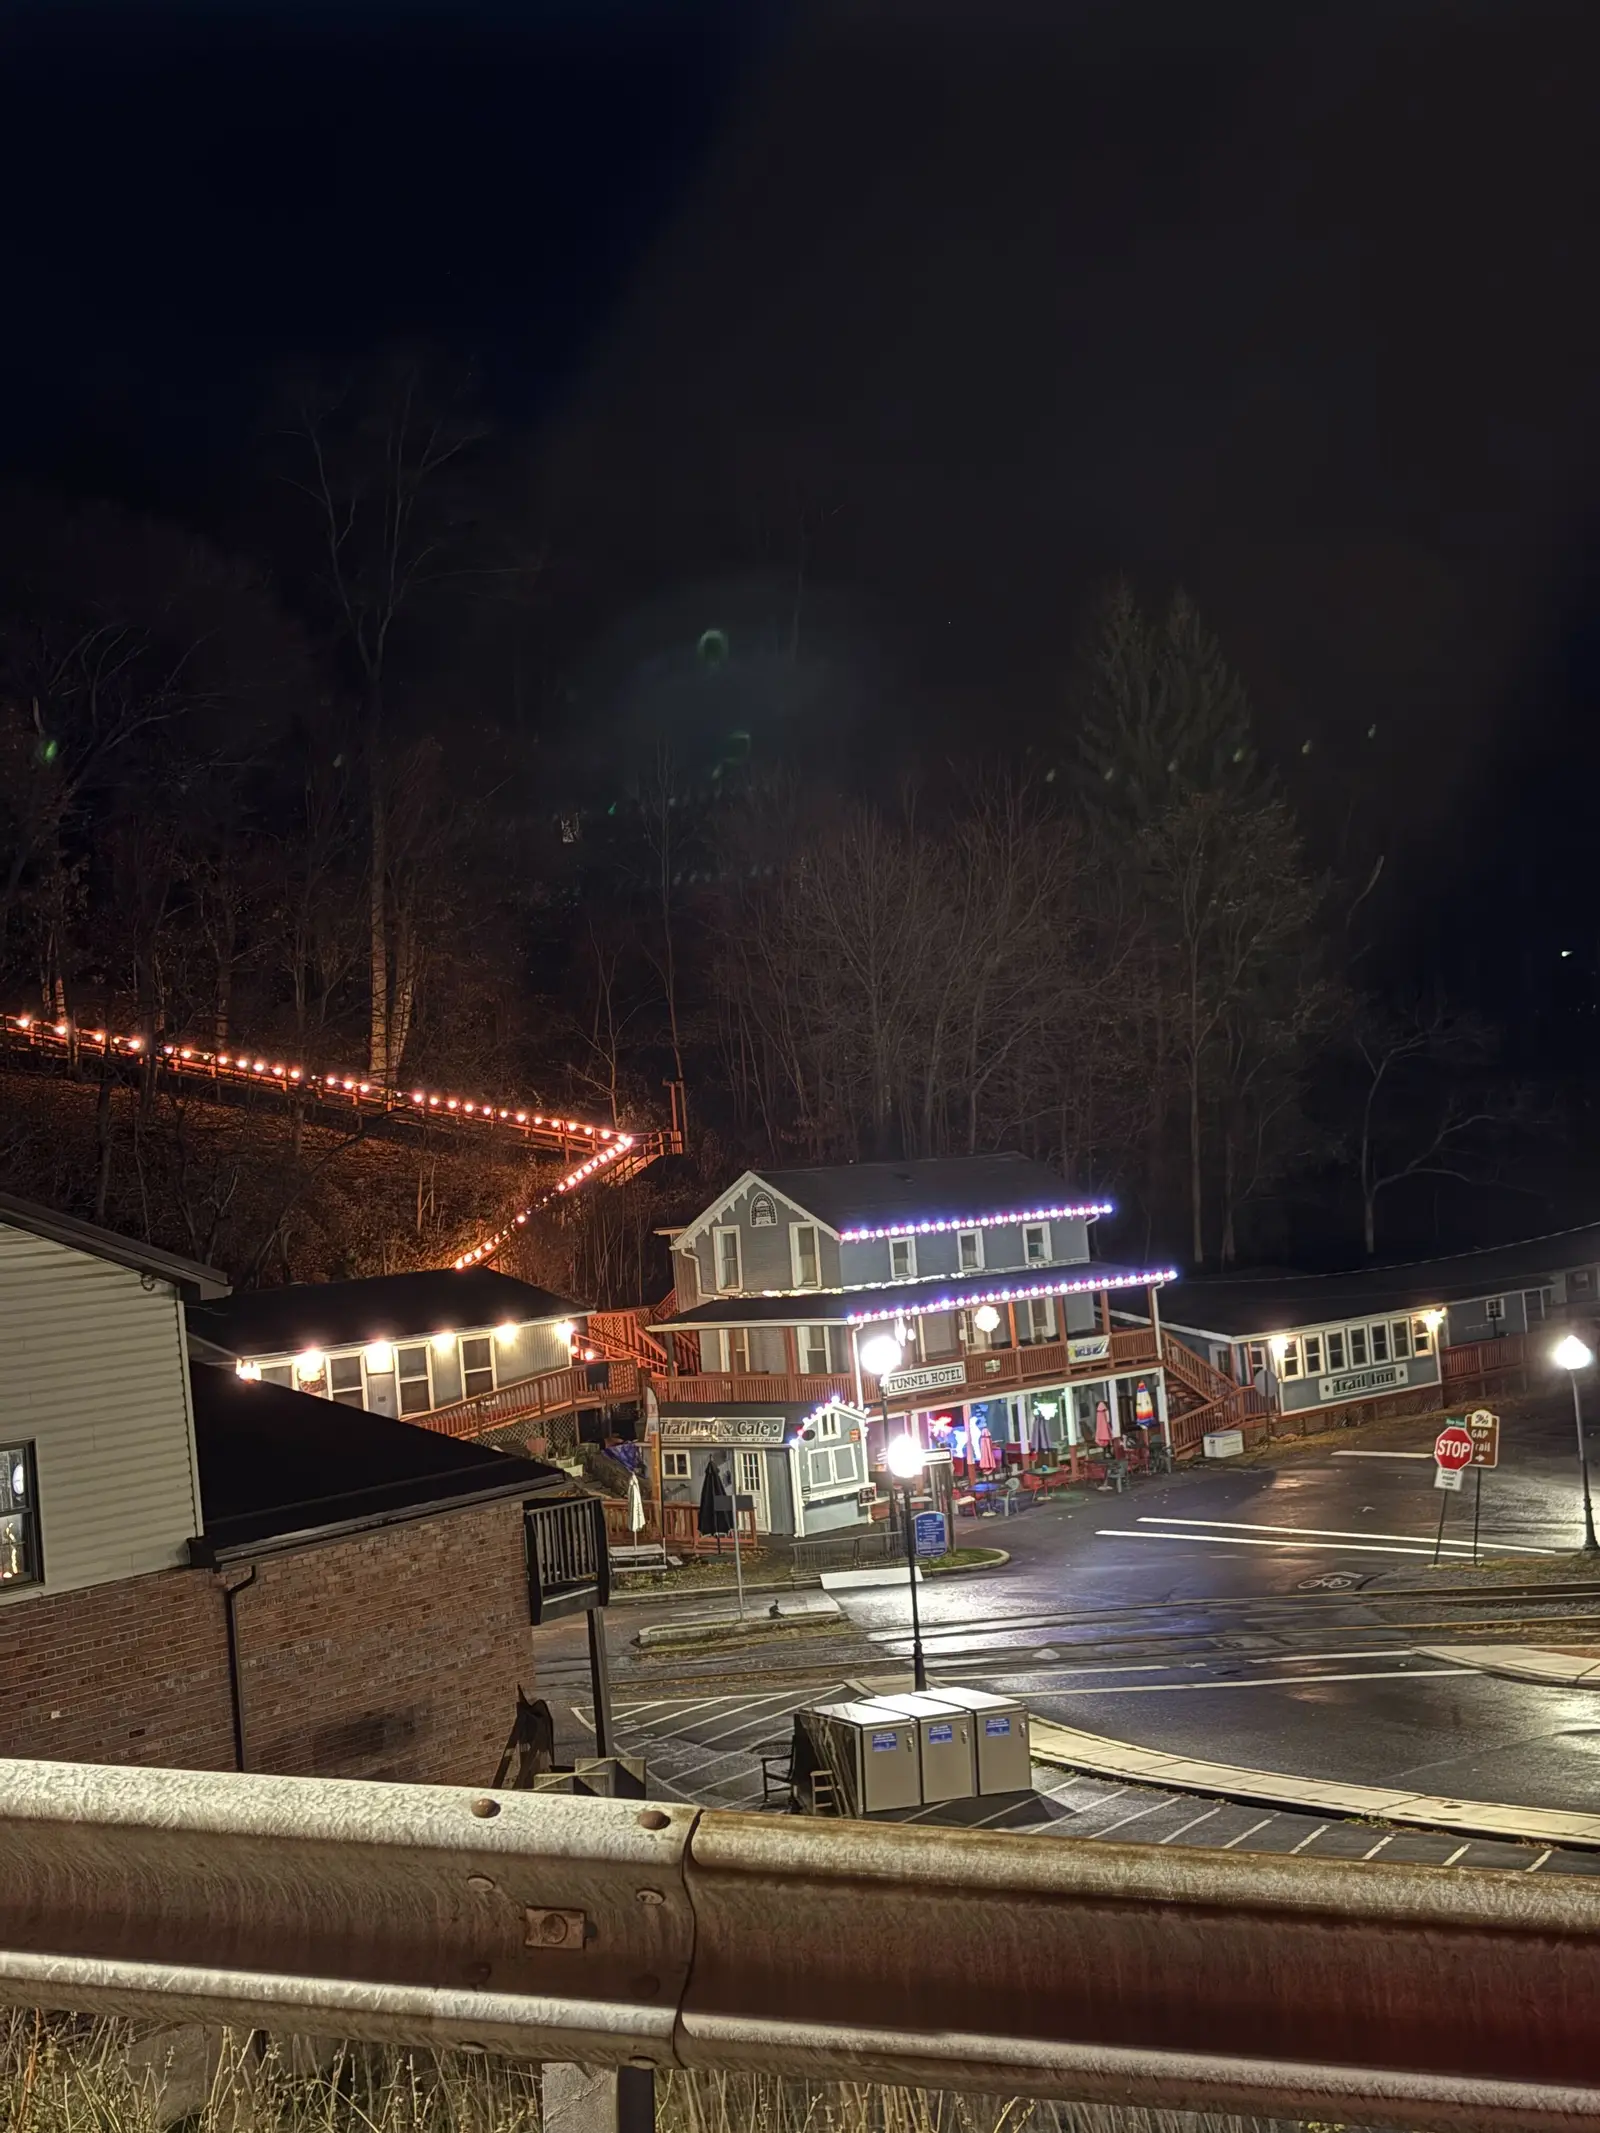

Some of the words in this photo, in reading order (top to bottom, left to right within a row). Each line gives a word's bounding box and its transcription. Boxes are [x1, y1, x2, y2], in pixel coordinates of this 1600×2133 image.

[889, 1374, 929, 1390] TUNNEL
[930, 1369, 962, 1383] HOTEL
[1333, 1373, 1366, 1392] Trail
[1371, 1371, 1393, 1385] Inn
[660, 1421, 691, 1435] Trail
[722, 1422, 734, 1436] &
[737, 1421, 770, 1436] Cafe
[1471, 1429, 1489, 1439] GAP
[1437, 1440, 1471, 1458] STOP
[1473, 1442, 1491, 1452] rail
